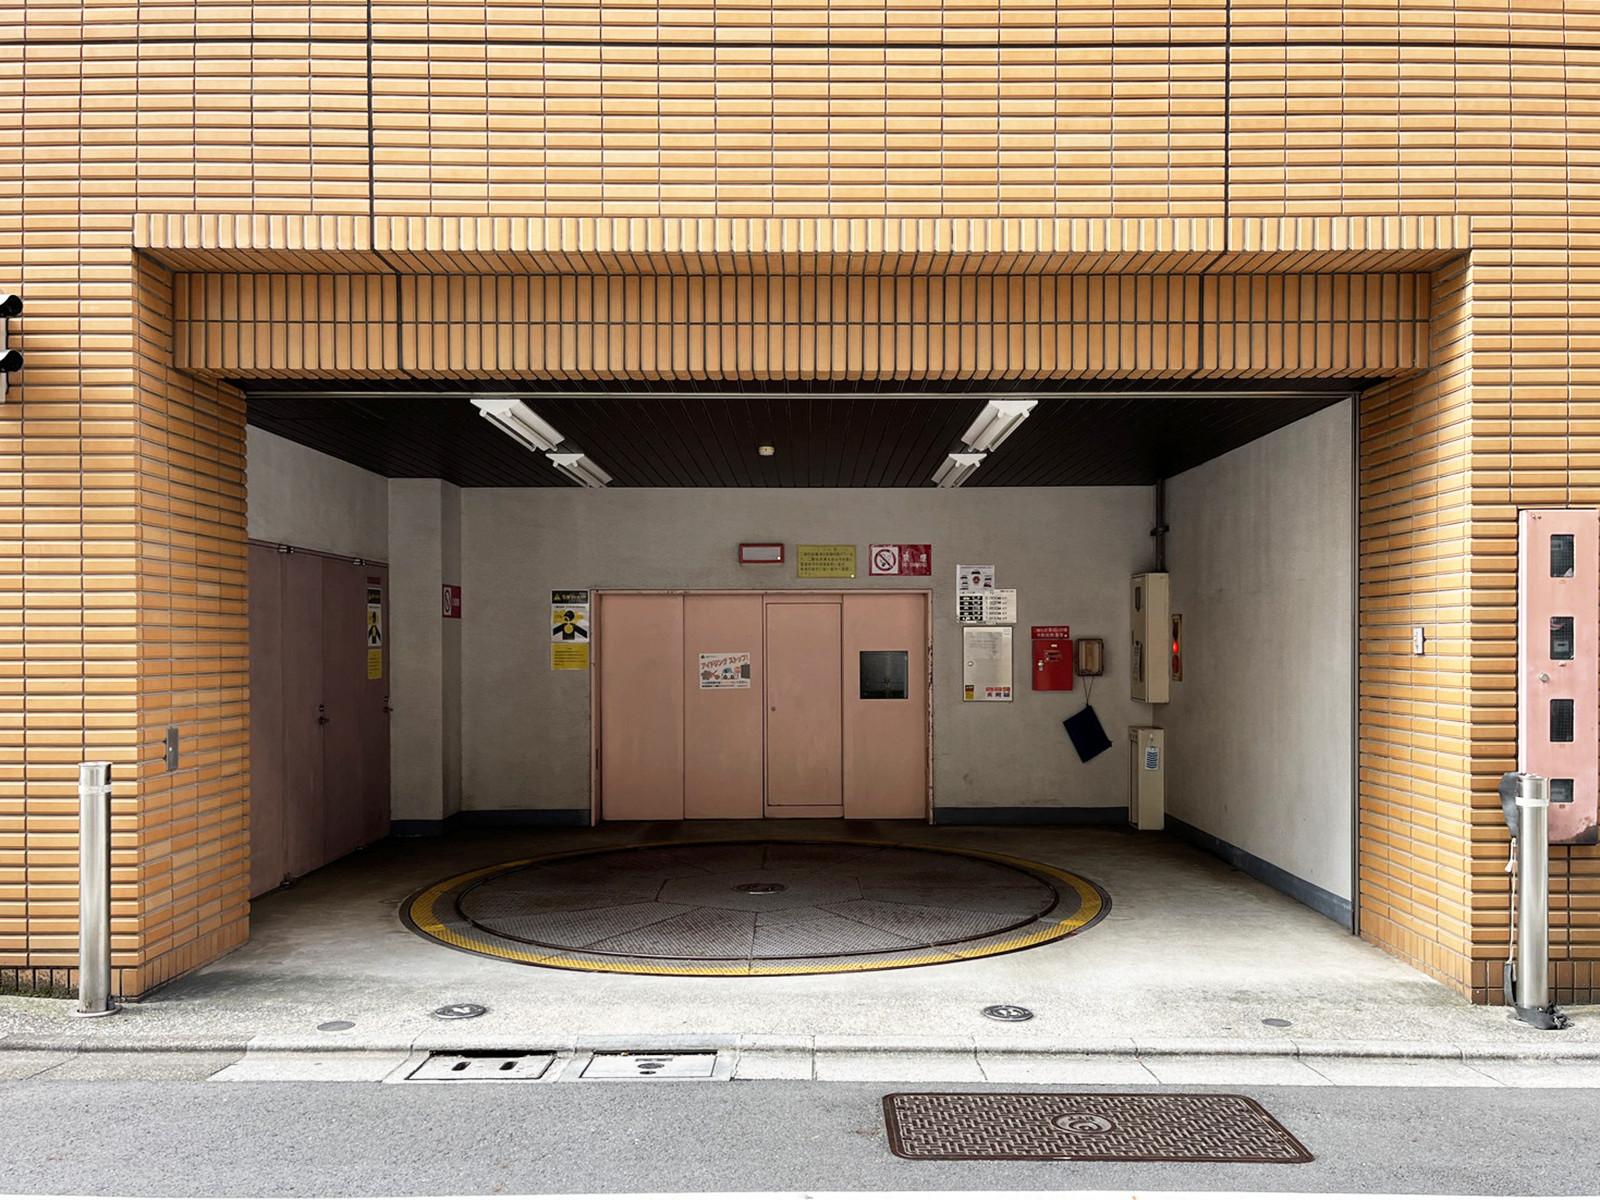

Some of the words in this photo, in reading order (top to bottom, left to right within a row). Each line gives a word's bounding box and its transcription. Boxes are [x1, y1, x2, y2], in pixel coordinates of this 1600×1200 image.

[701, 657, 727, 670] アイドリング
